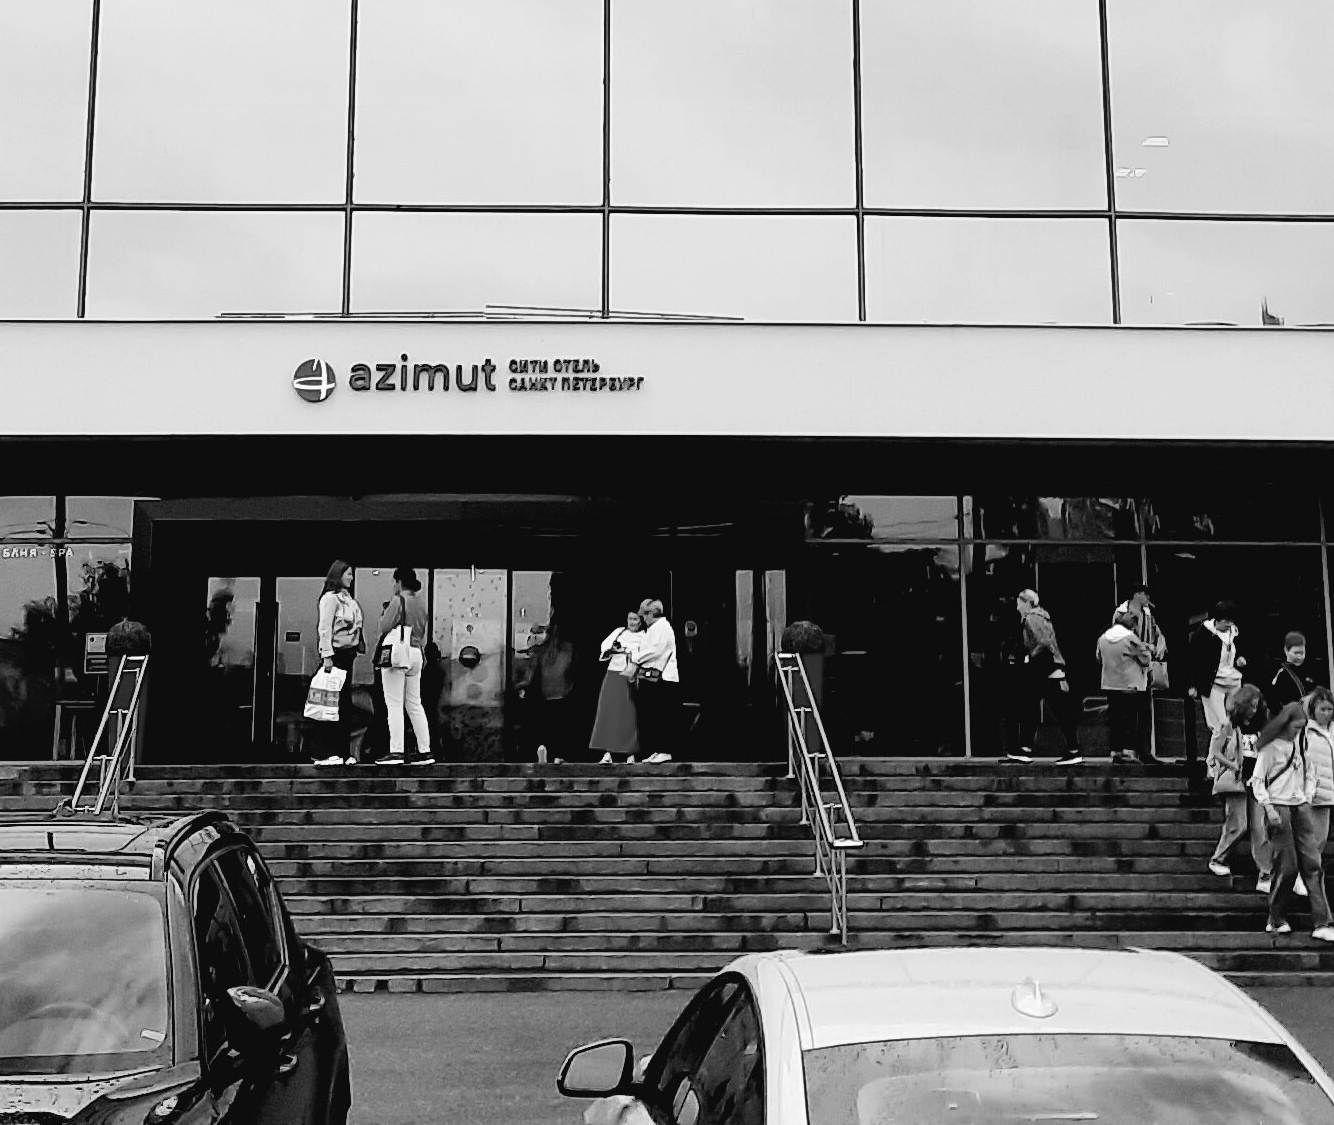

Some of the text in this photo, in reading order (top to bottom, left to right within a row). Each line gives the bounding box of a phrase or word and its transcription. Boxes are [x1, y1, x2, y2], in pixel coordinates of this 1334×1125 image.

[348, 353, 497, 392] azimut
[508, 359, 600, 373] СИТИ ОТЕЛЬ
[508, 377, 645, 391] САНКТ ПЕТЕРБУРГ
